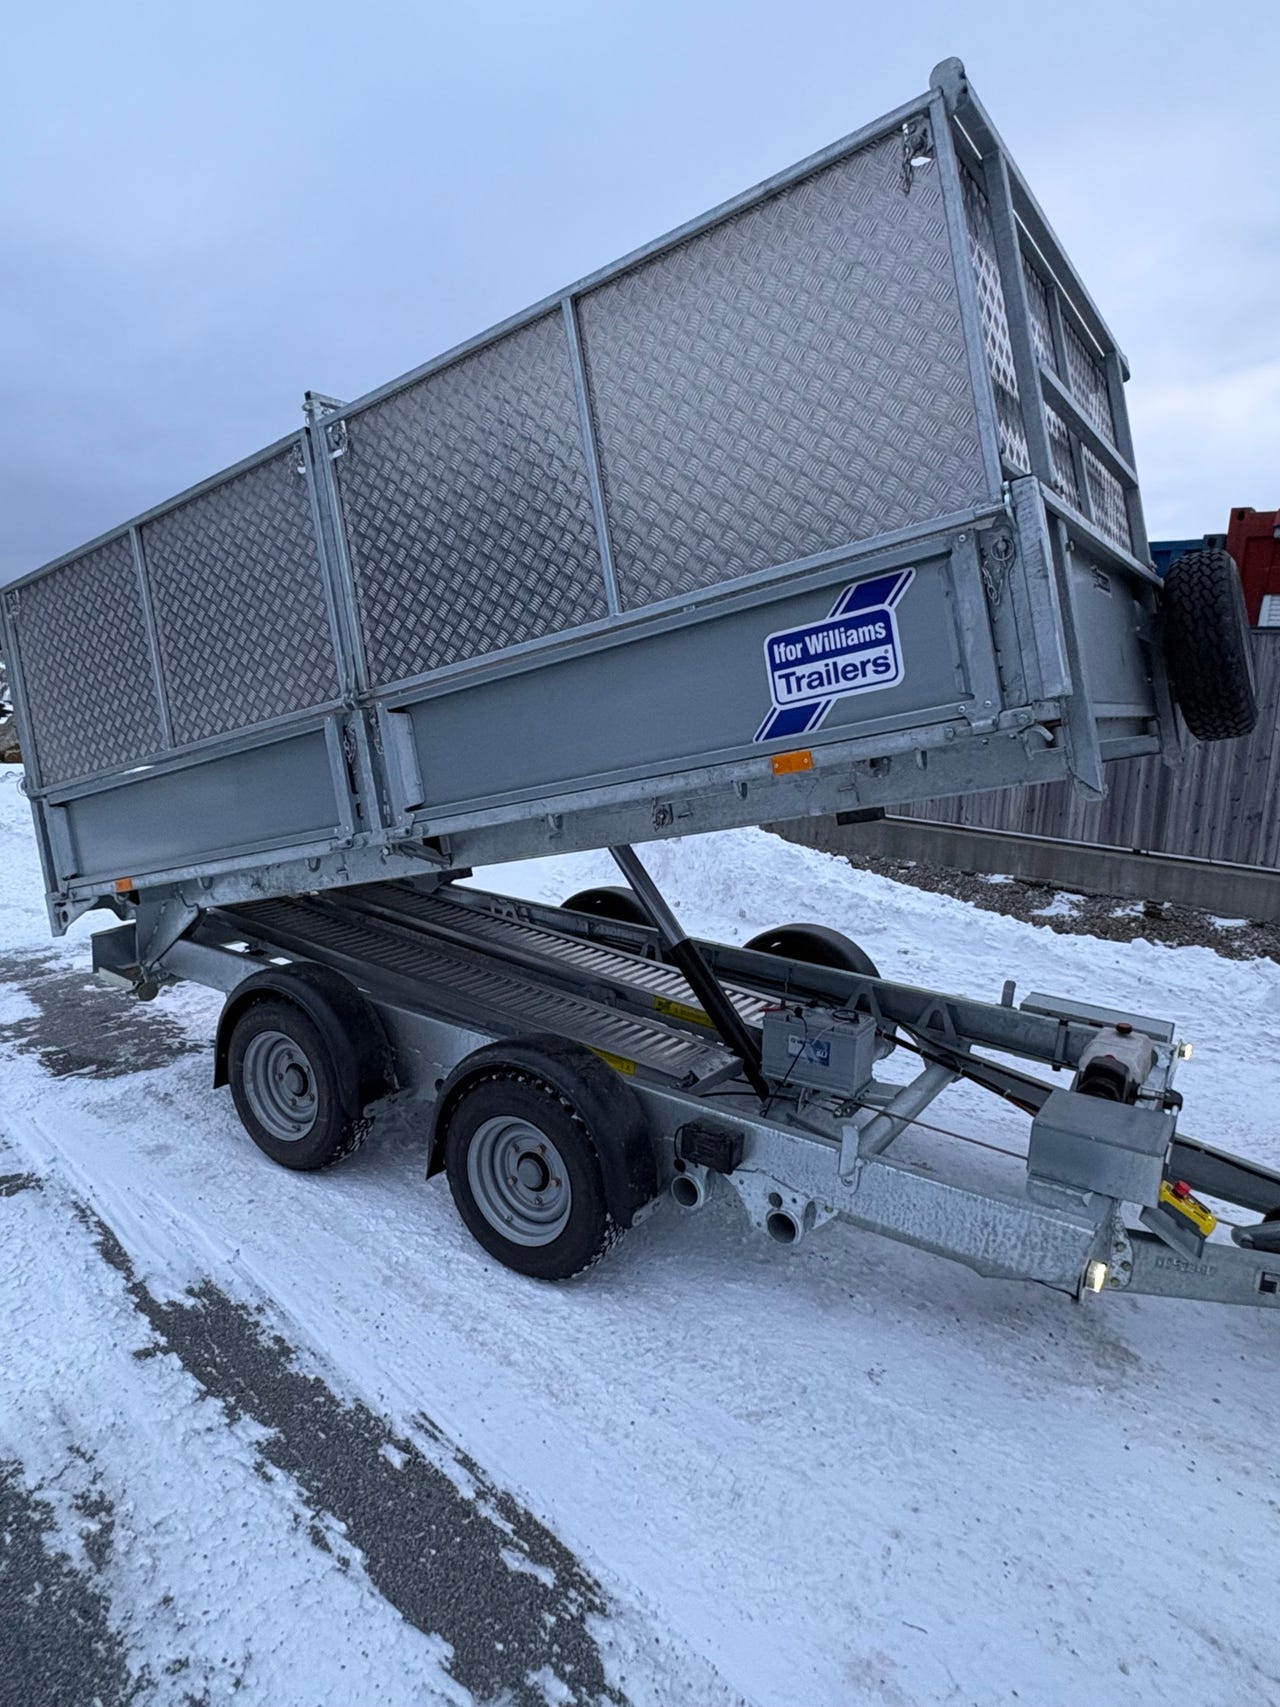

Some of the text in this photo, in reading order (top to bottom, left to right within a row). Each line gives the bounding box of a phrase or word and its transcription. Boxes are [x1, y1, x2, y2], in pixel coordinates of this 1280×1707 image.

[773, 622, 886, 664] Ifor Williams
[778, 655, 891, 695] Trailers
